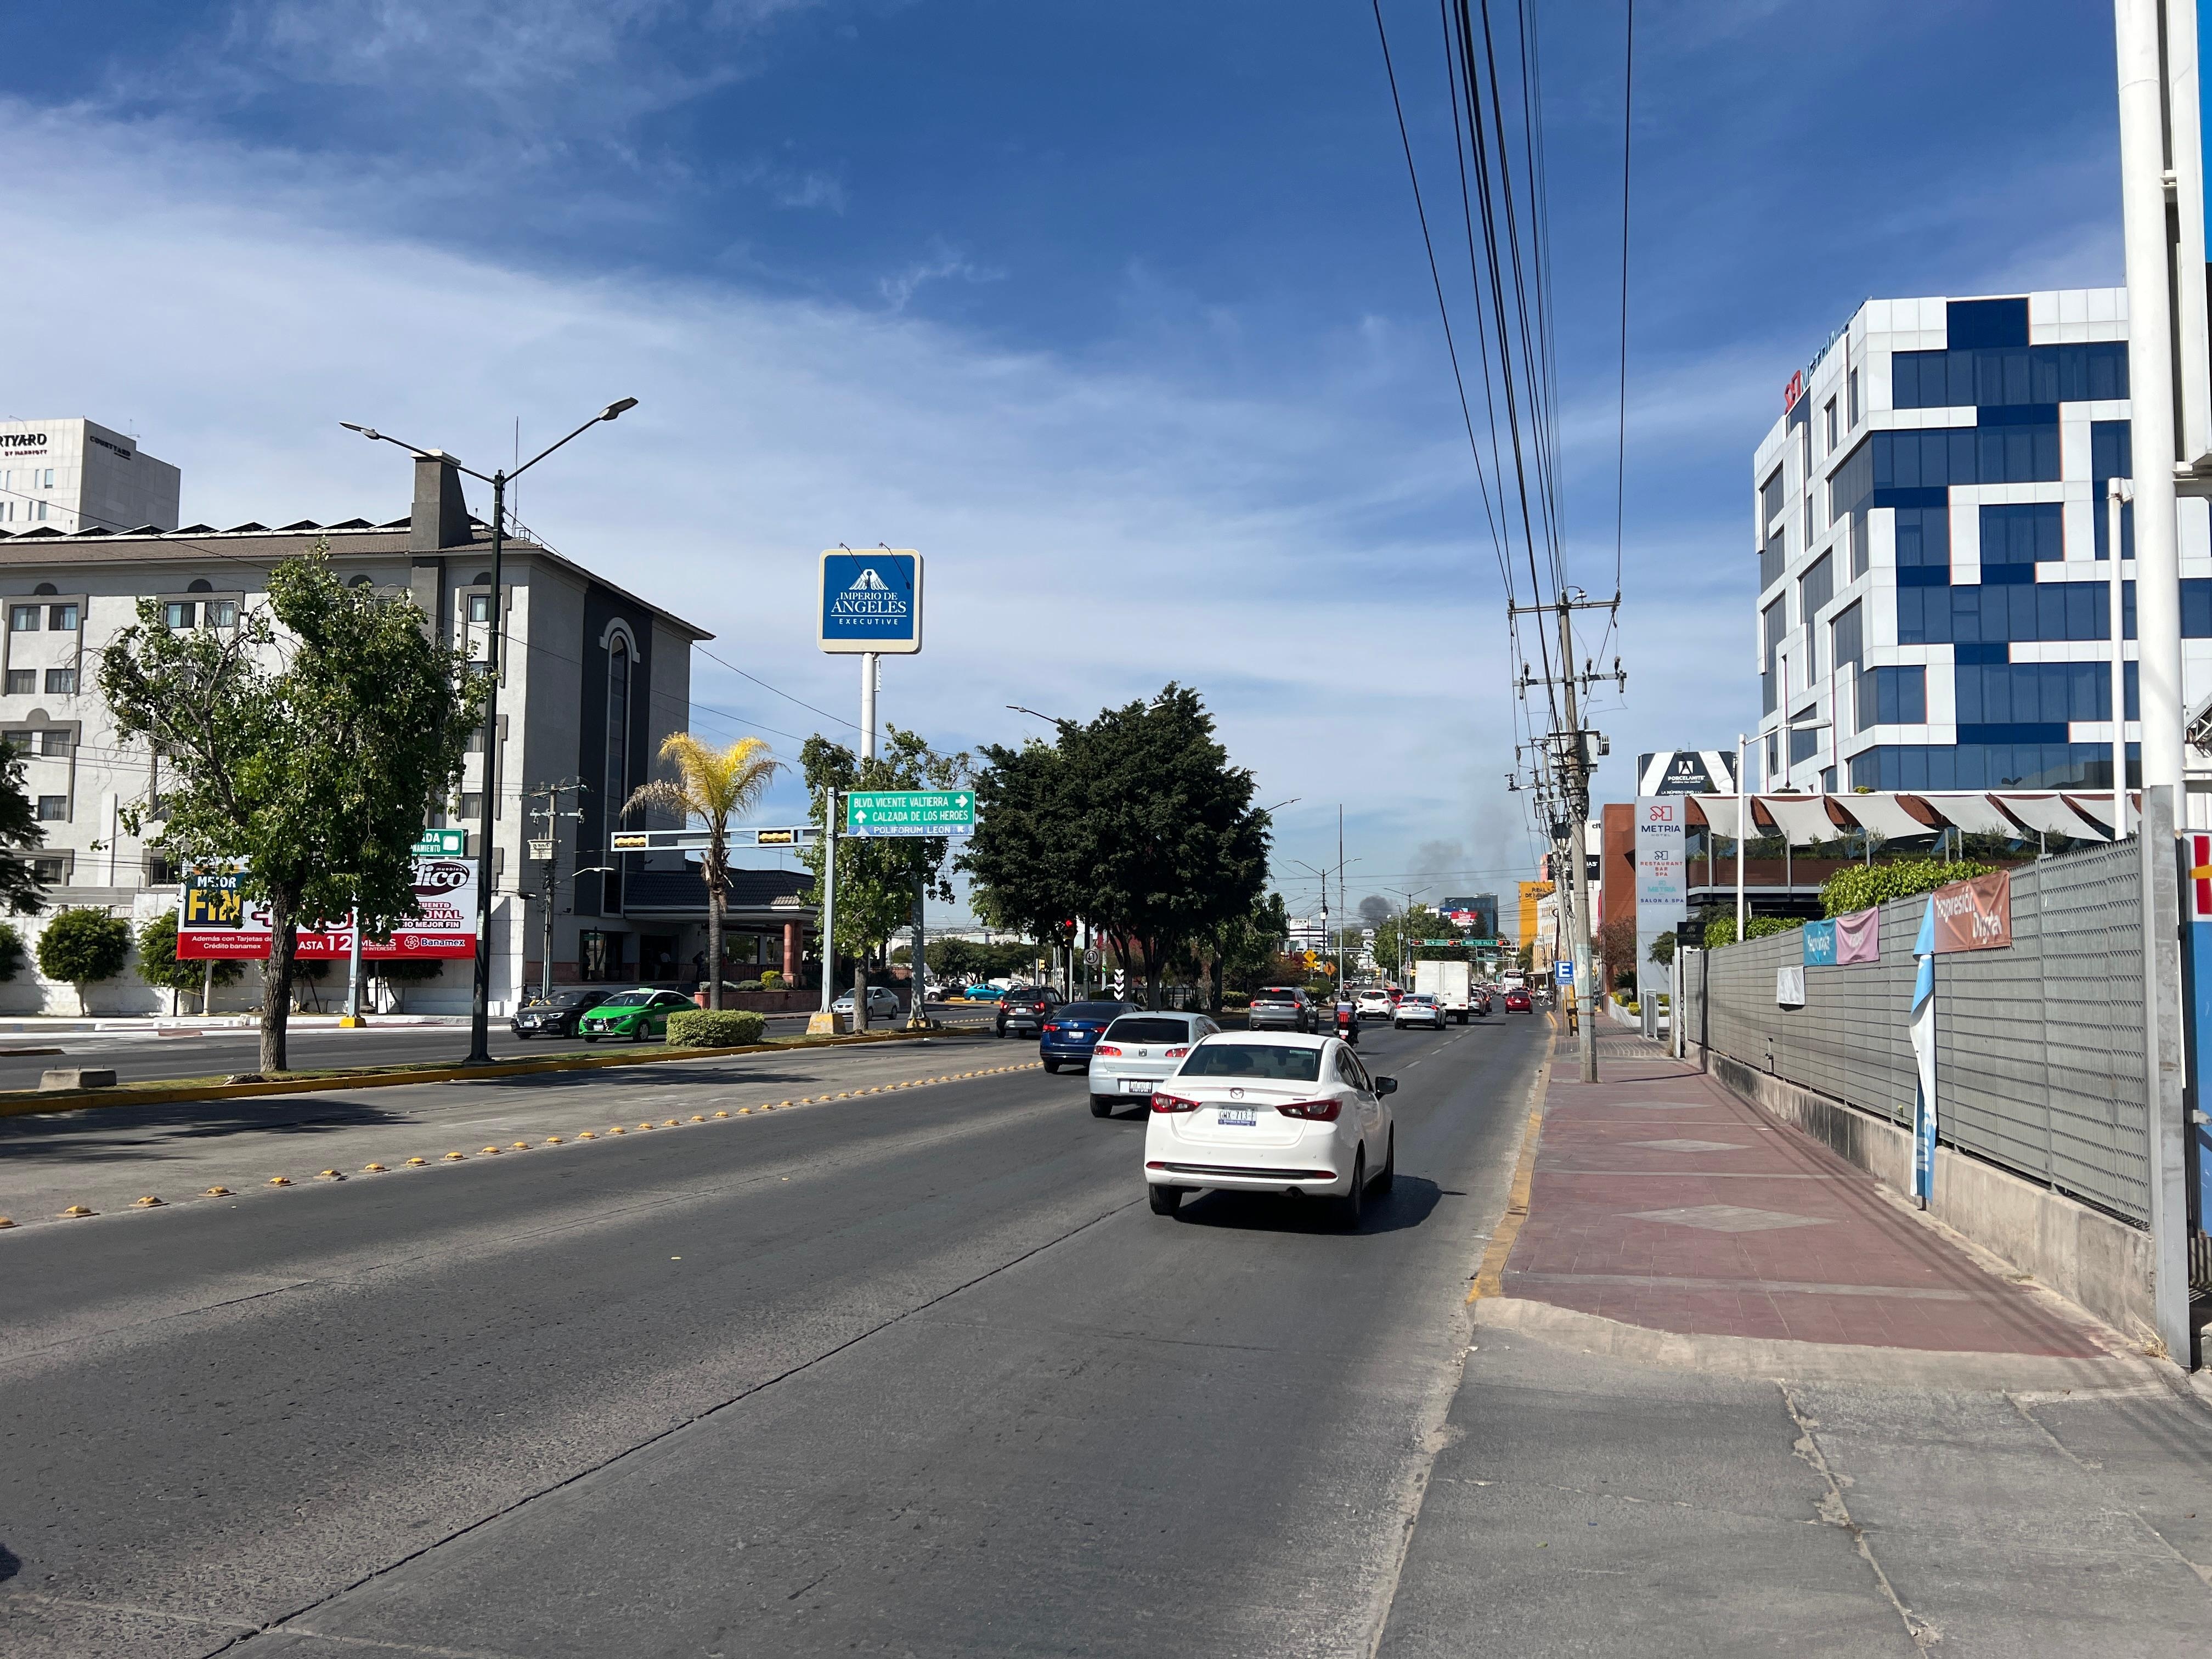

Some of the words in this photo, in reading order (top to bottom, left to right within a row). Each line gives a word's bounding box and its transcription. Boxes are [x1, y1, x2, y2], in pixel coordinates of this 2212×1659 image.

[840, 592, 881, 600] IMPERIO
[884, 592, 898, 600] DE
[831, 597, 906, 613] ÁNGELES
[854, 798, 873, 808] BLVD.
[877, 797, 907, 808] VICENTE
[910, 797, 949, 807] VALTIERRA
[872, 811, 907, 821] CALZADA
[911, 811, 921, 821] DE
[923, 811, 937, 821] LOS
[940, 810, 968, 821] HEROES
[298, 941, 324, 950] ASTA
[326, 935, 352, 951] 12
[1559, 963, 1570, 977] E
